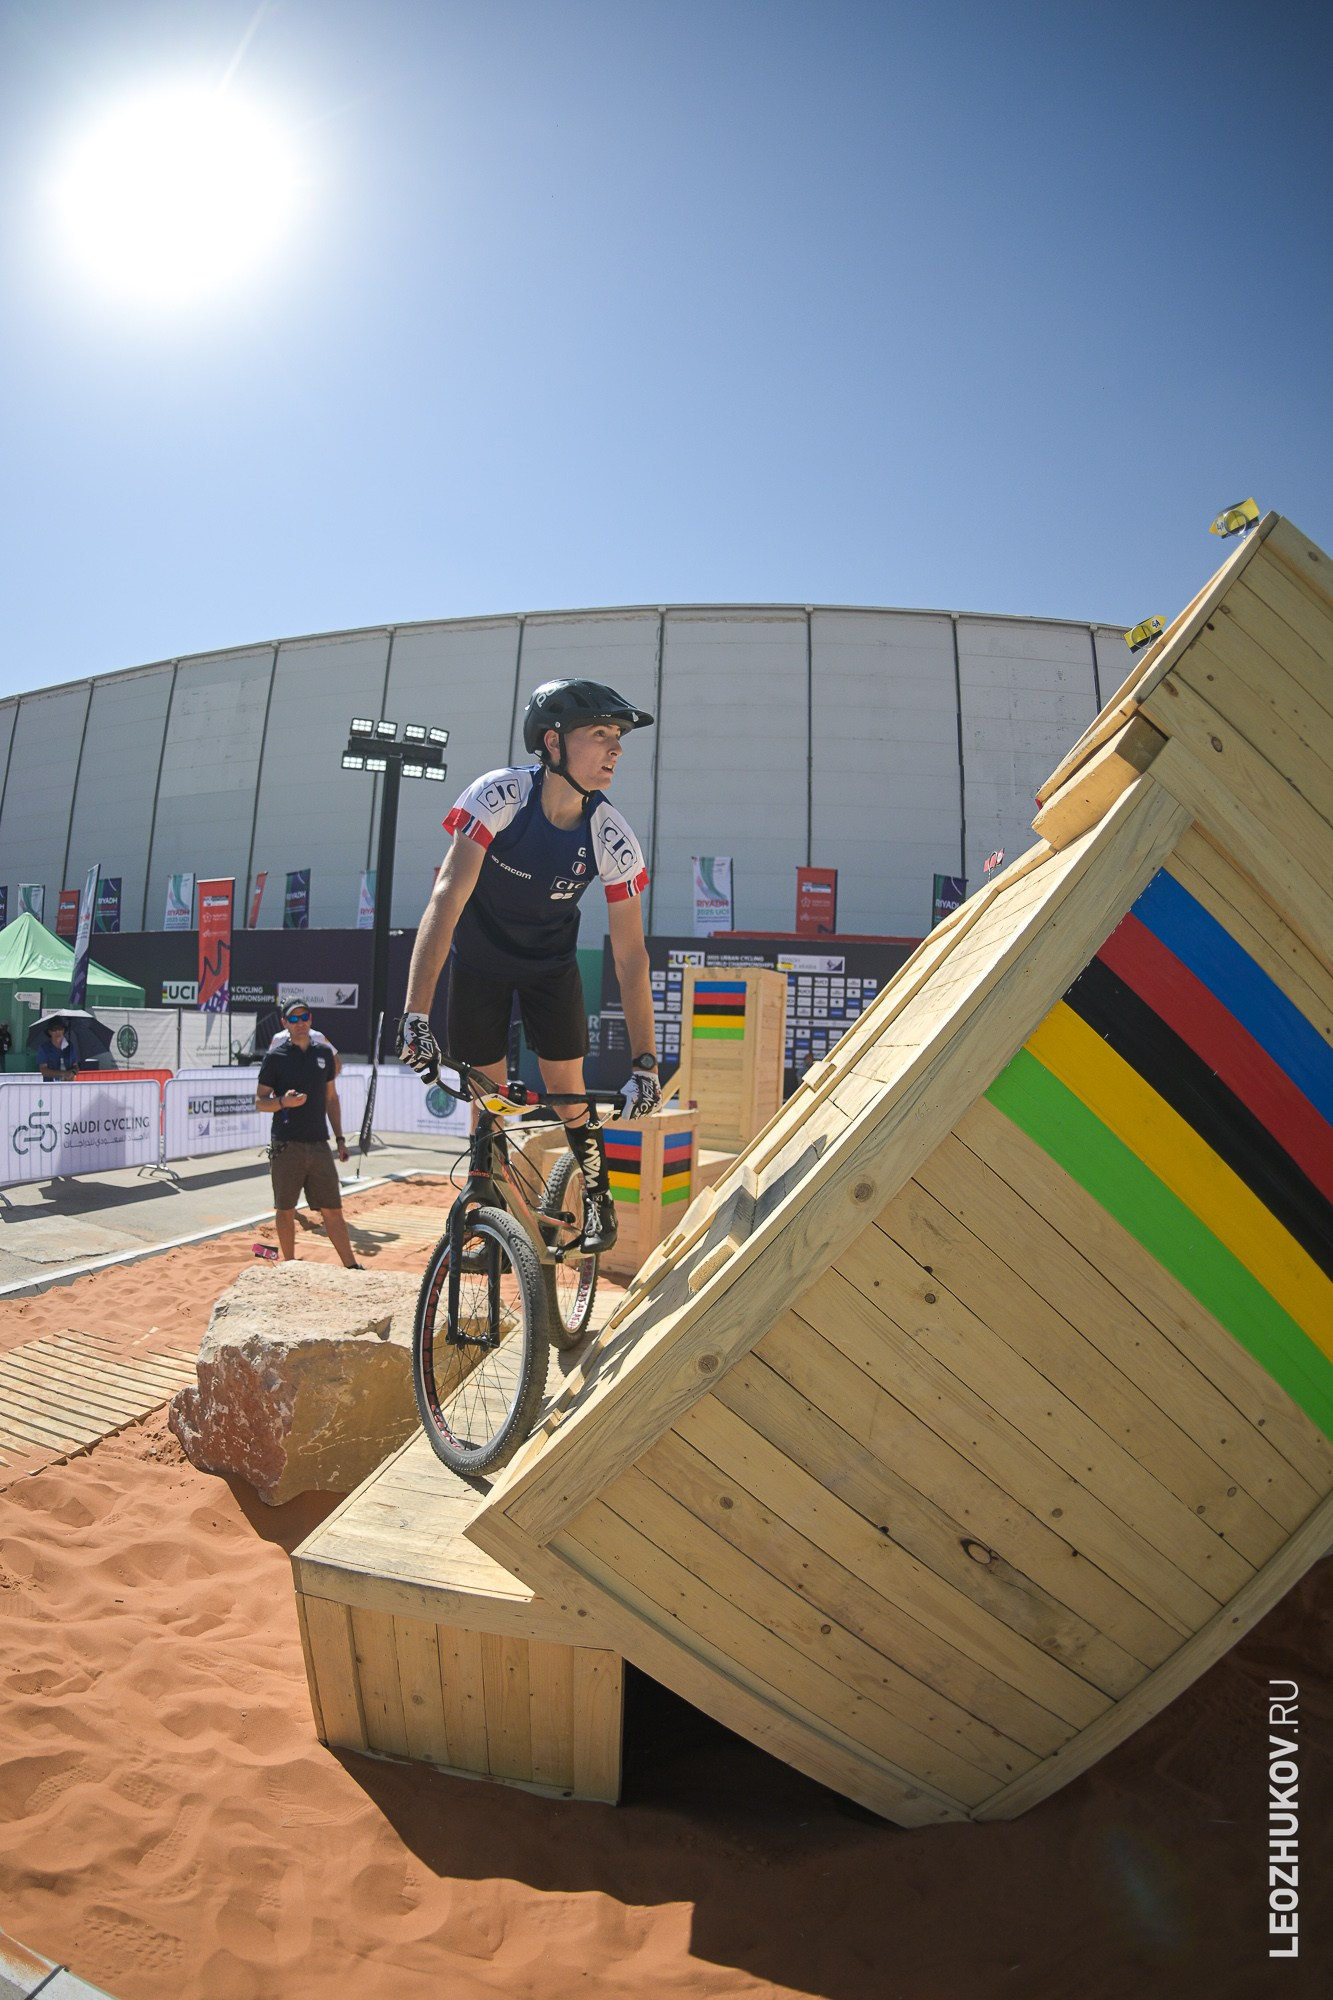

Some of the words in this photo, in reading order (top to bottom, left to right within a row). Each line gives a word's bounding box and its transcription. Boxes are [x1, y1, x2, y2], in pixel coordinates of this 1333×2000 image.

[485, 783, 517, 808] CIC
[603, 826, 634, 866] CIC
[935, 899, 959, 909] RIYAD
[675, 954, 701, 966] UCI
[168, 985, 195, 1000] UCI
[236, 986, 263, 994] CYCLING
[231, 995, 275, 1003] AMPIONSHIPS
[193, 1100, 212, 1114] UCI
[63, 1120, 100, 1135] SAUDI
[104, 1116, 150, 1131] CYCLING
